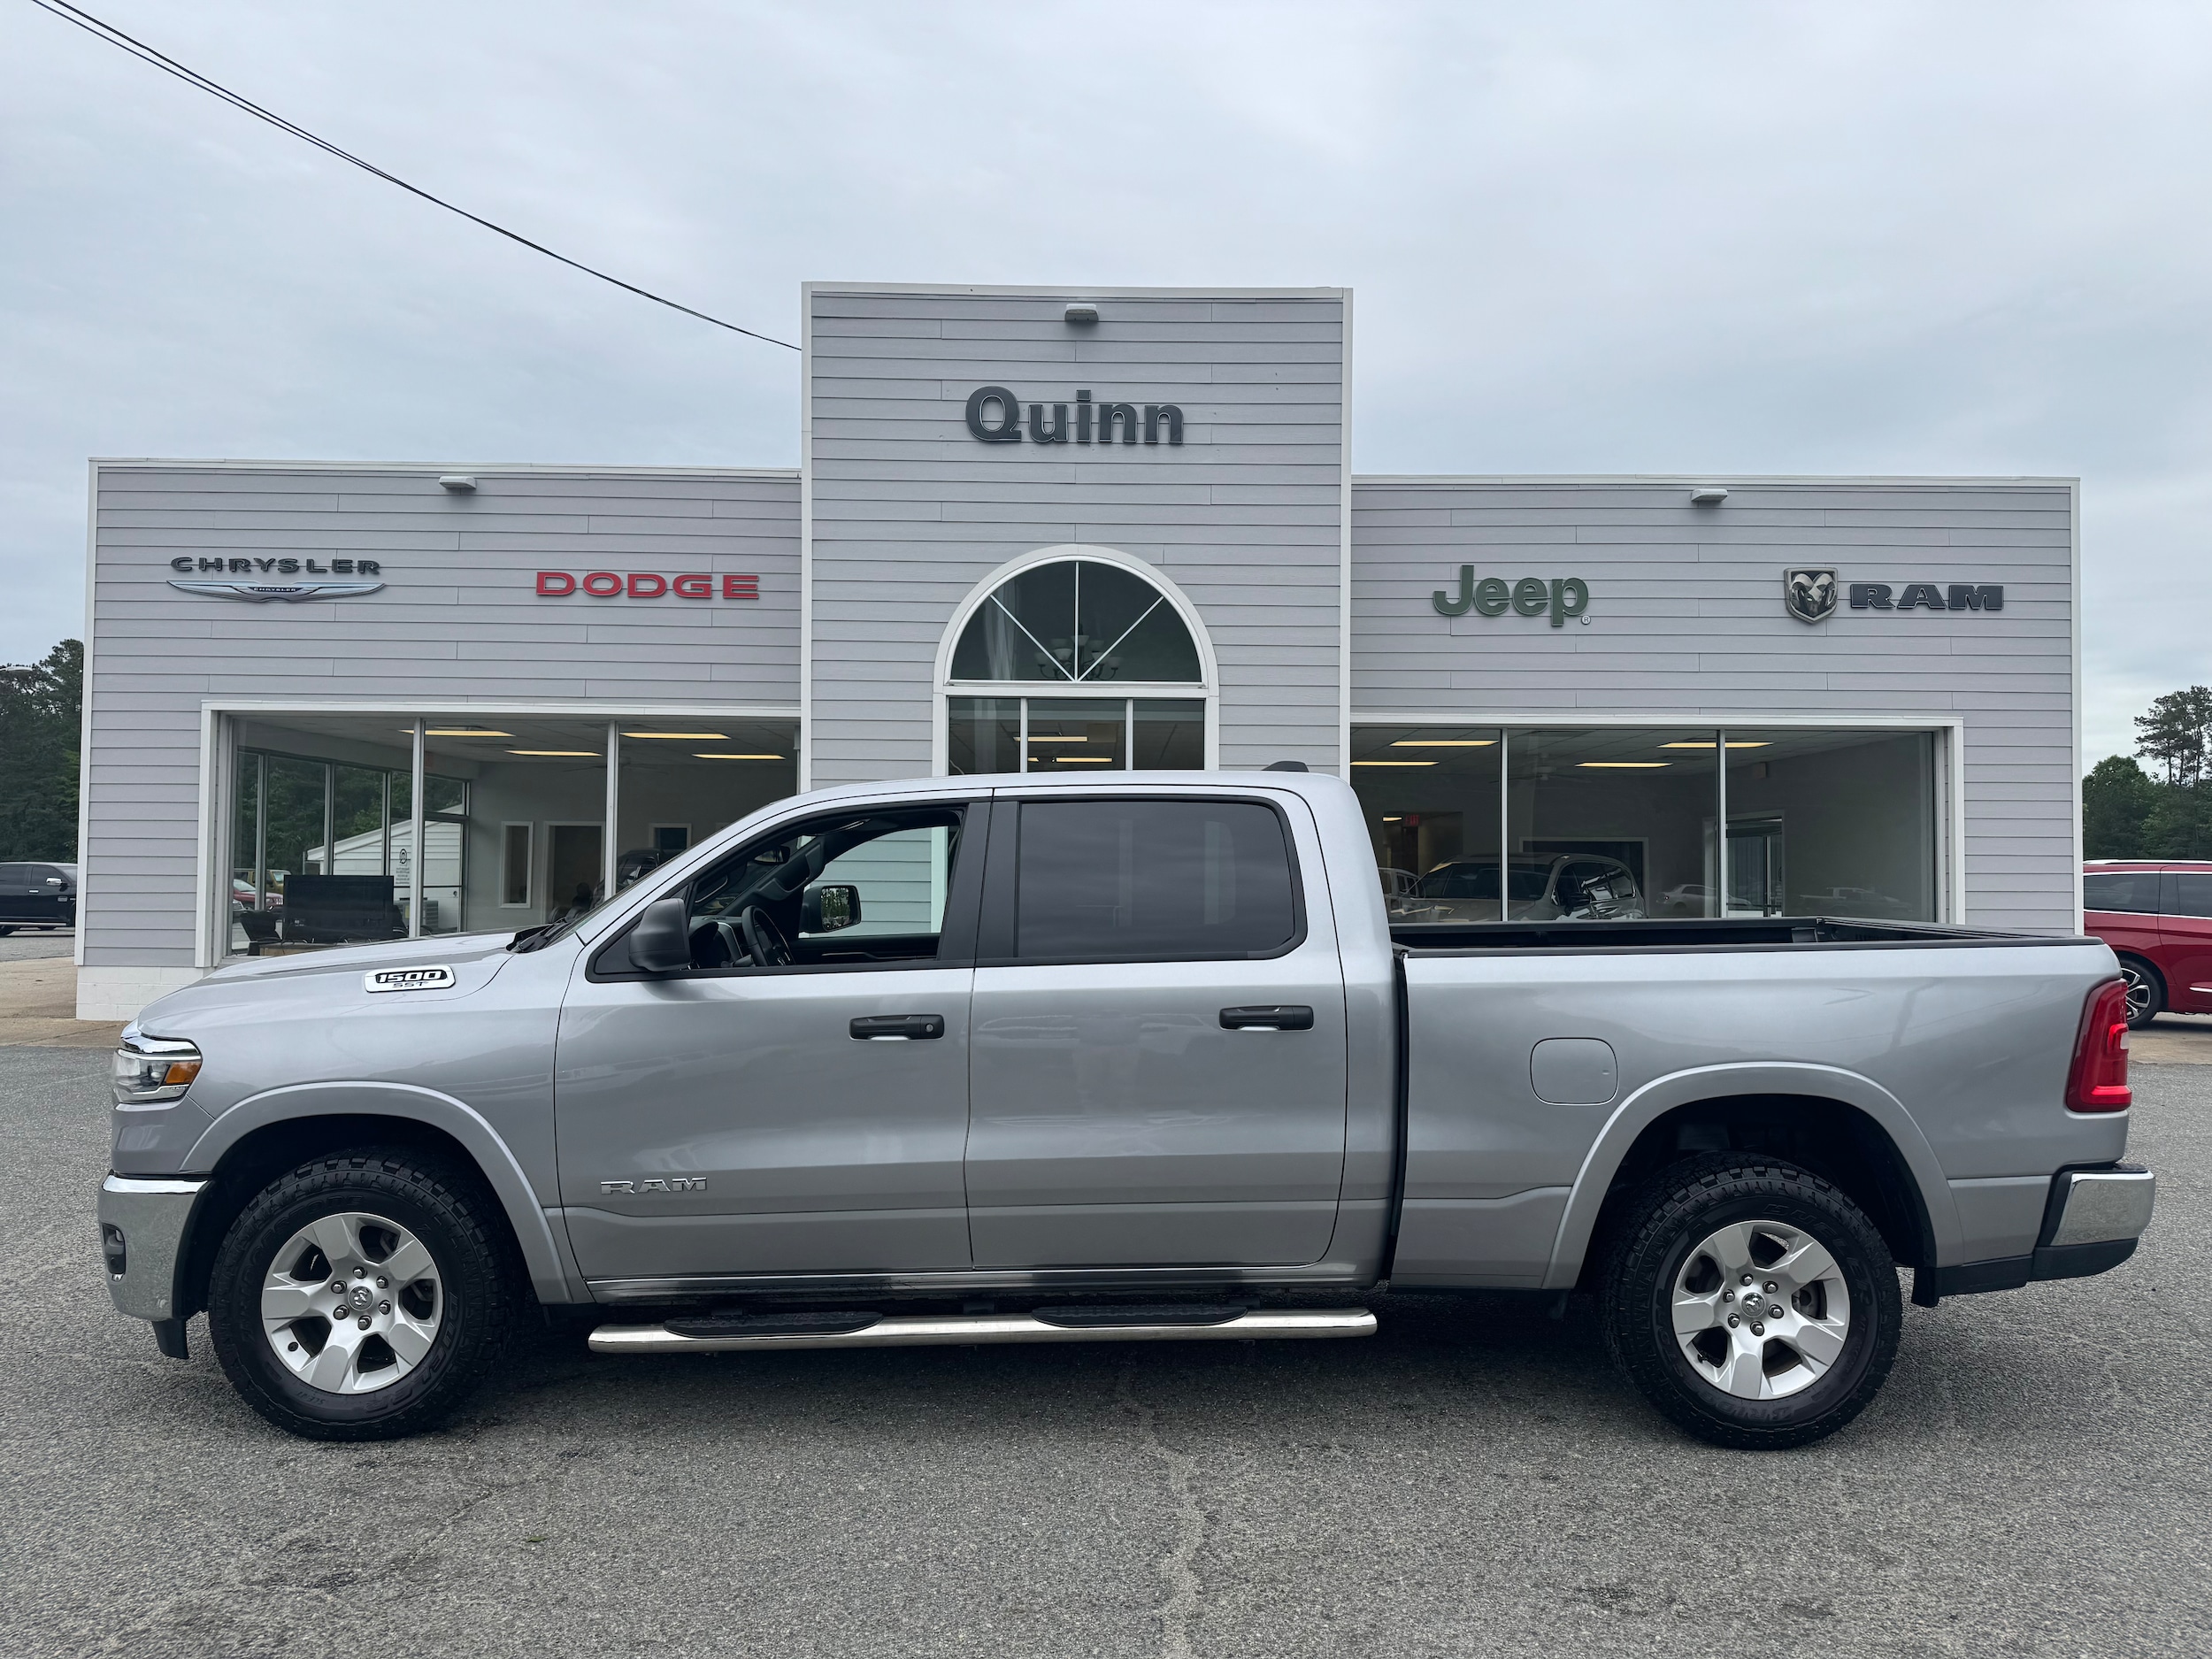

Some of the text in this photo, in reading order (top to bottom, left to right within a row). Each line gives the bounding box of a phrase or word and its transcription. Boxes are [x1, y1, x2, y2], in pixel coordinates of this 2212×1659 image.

[965, 386, 1184, 442] Quinn
[170, 557, 380, 574] CHRYSLER
[536, 572, 759, 599] DODGE
[1432, 565, 1589, 626] Jeep
[1850, 584, 2005, 610] RAM
[378, 971, 442, 983] 1500
[600, 1177, 707, 1194] RAM
